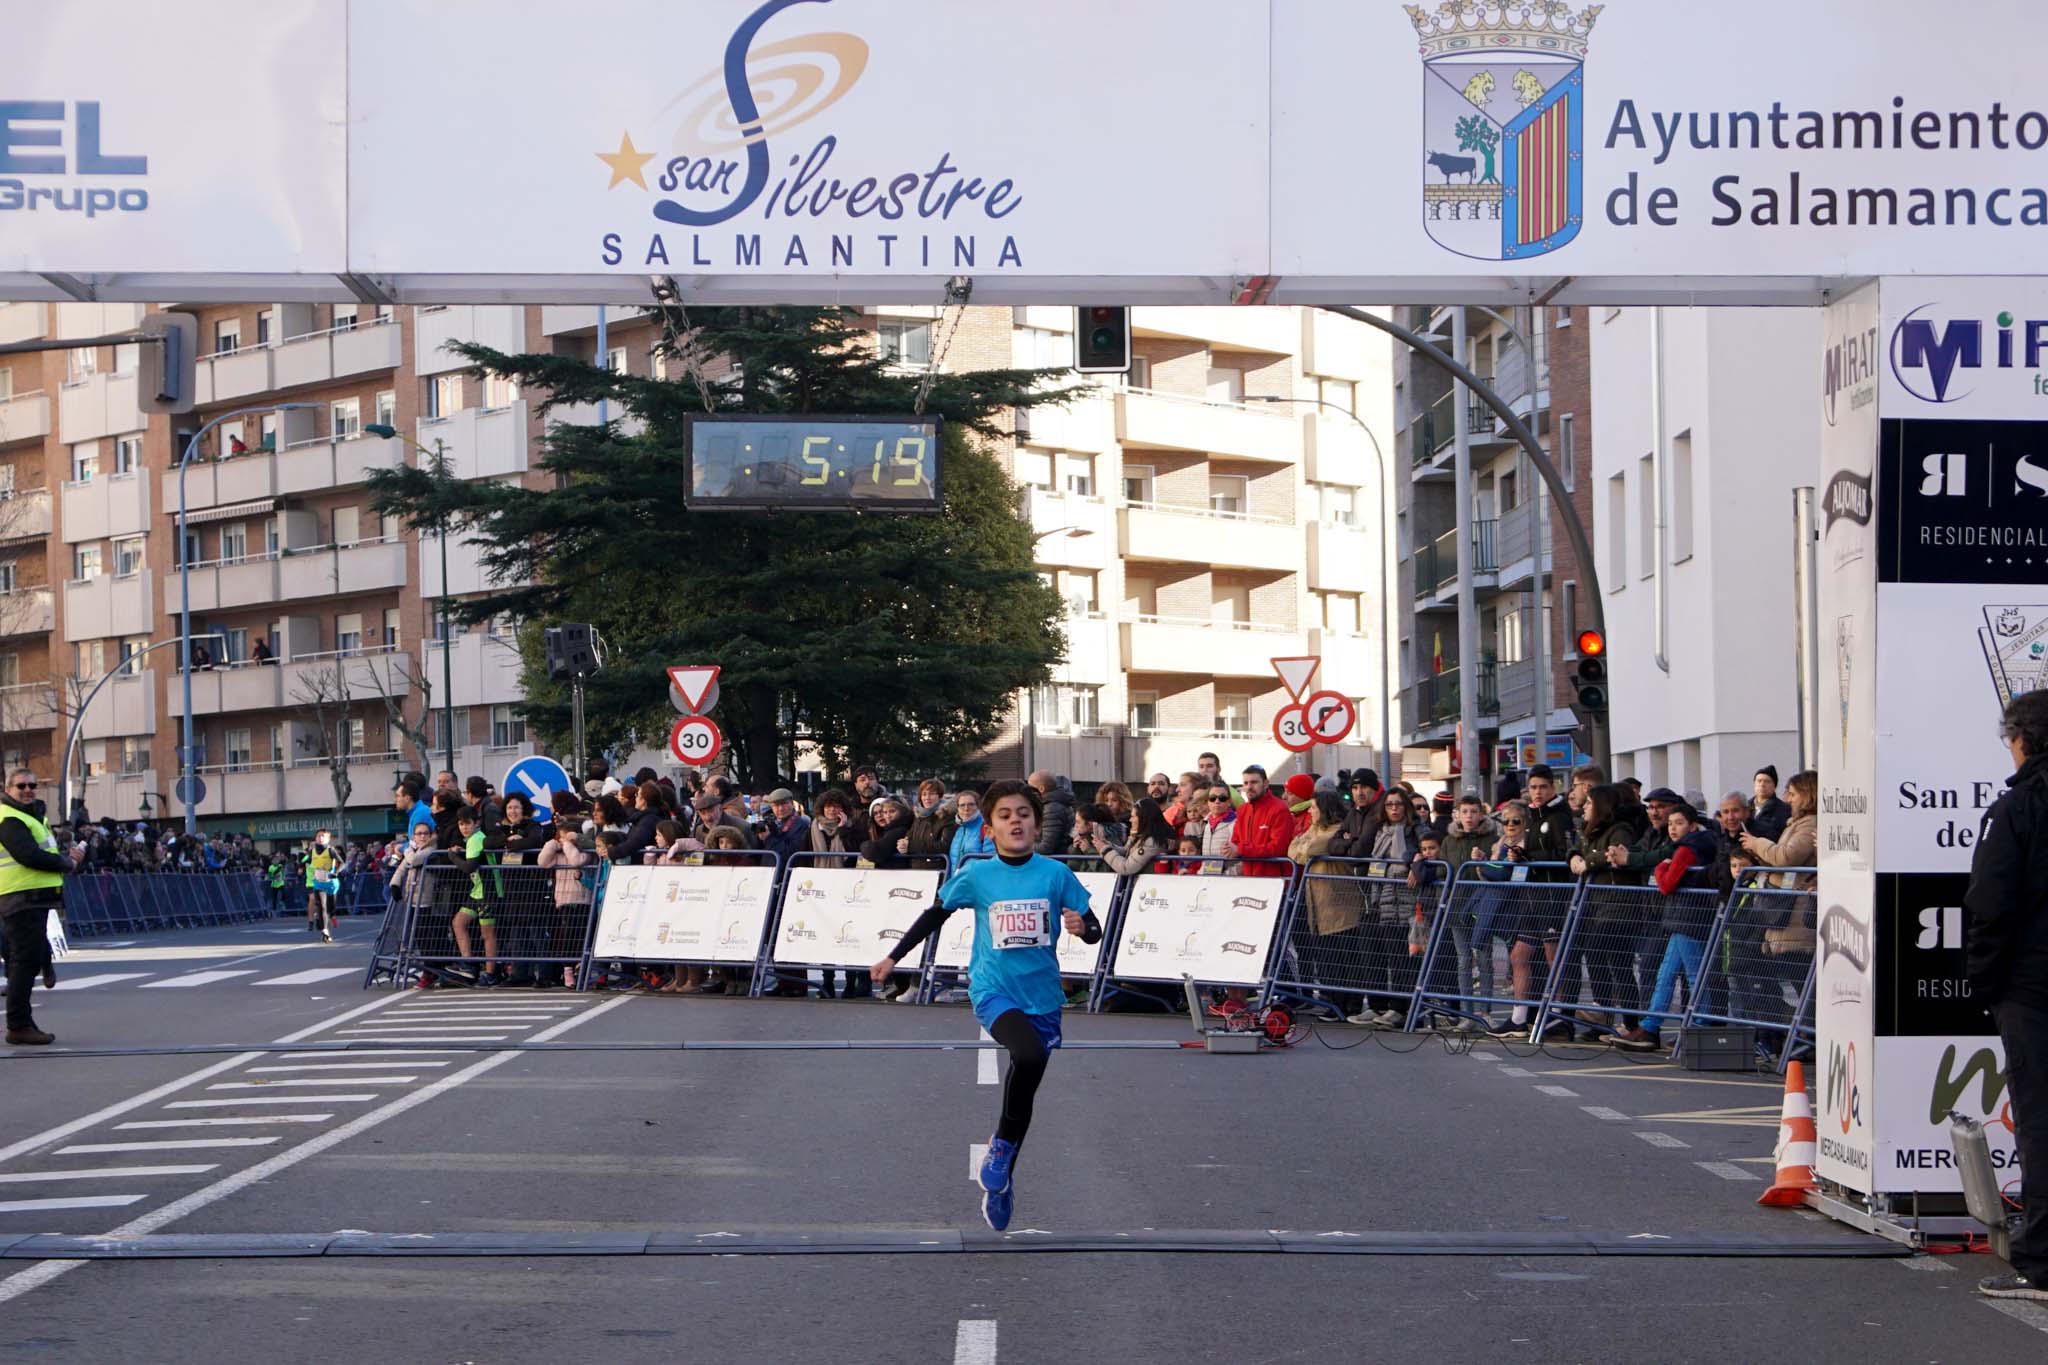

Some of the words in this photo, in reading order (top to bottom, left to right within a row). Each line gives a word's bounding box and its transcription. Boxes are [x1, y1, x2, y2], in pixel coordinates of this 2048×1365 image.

[1604, 96, 2048, 164] Ayuntamiento
[1605, 172, 1680, 226] de
[1711, 172, 2048, 227] Salamanca
[602, 233, 1022, 267] SALMANTINA
[1921, 526, 2048, 547] RESIDENCIAL
[2011, 625, 2044, 651] JESUITAS
[683, 733, 708, 748] 30
[1899, 781, 1959, 809] San
[1936, 821, 1973, 848] de
[996, 912, 1036, 932] 7035
